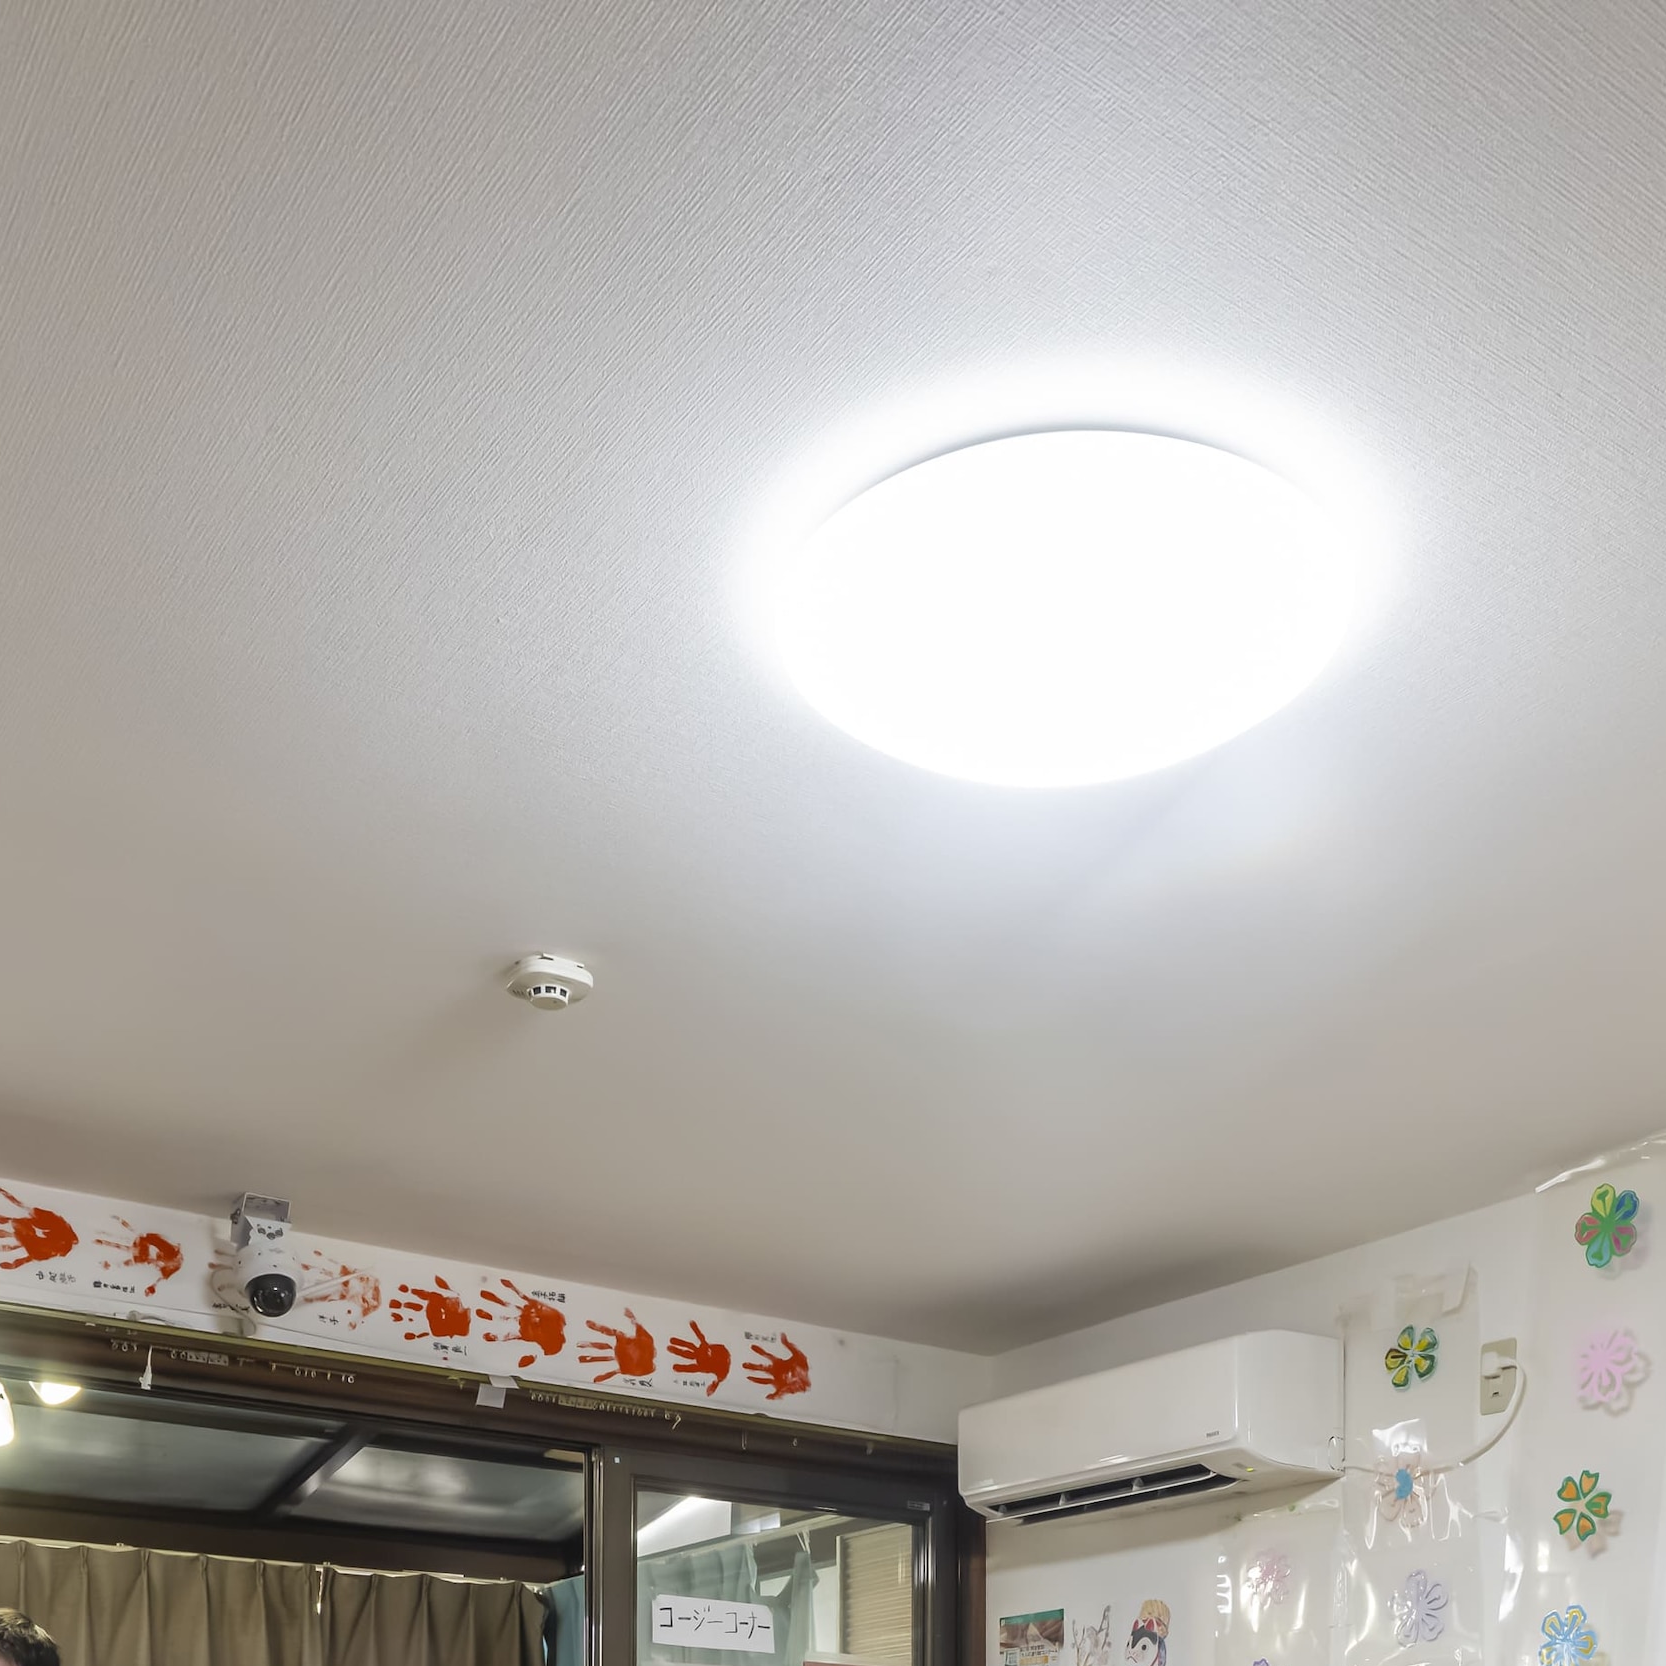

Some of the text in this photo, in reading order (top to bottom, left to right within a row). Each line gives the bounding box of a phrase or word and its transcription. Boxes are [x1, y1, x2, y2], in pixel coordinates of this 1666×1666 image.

[659, 1604, 771, 1640] コージーコーナー
